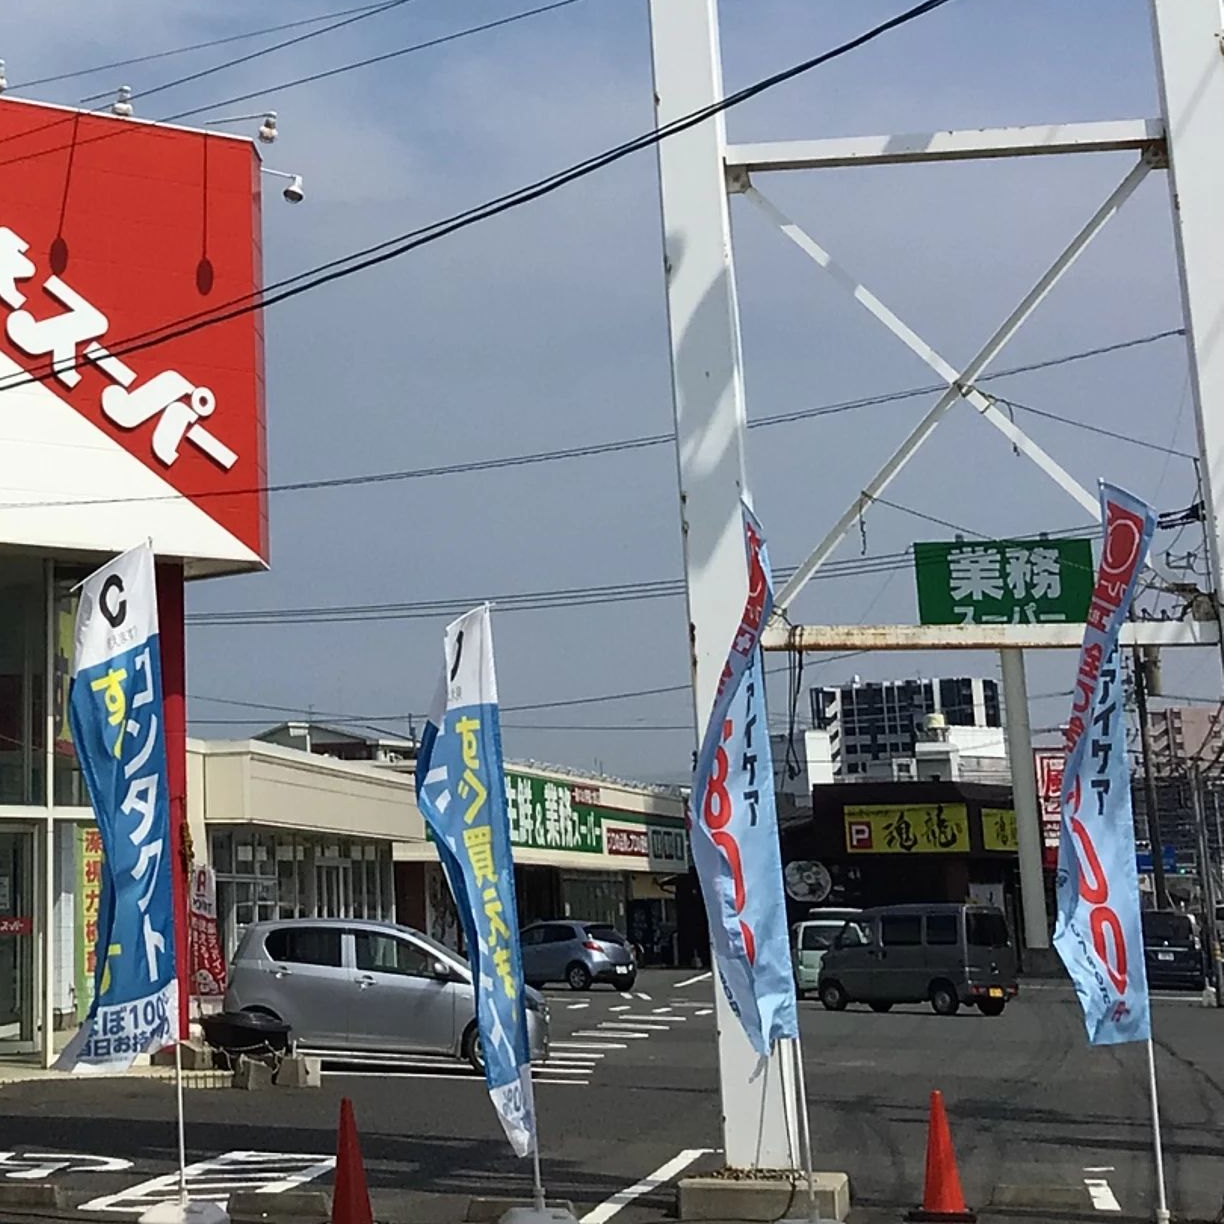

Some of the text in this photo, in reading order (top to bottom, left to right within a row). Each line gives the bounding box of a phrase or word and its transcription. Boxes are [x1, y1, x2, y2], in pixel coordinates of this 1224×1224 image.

[947, 546, 1062, 601] 業務
[121, 647, 165, 983] コンタクト
[851, 825, 869, 845] P
